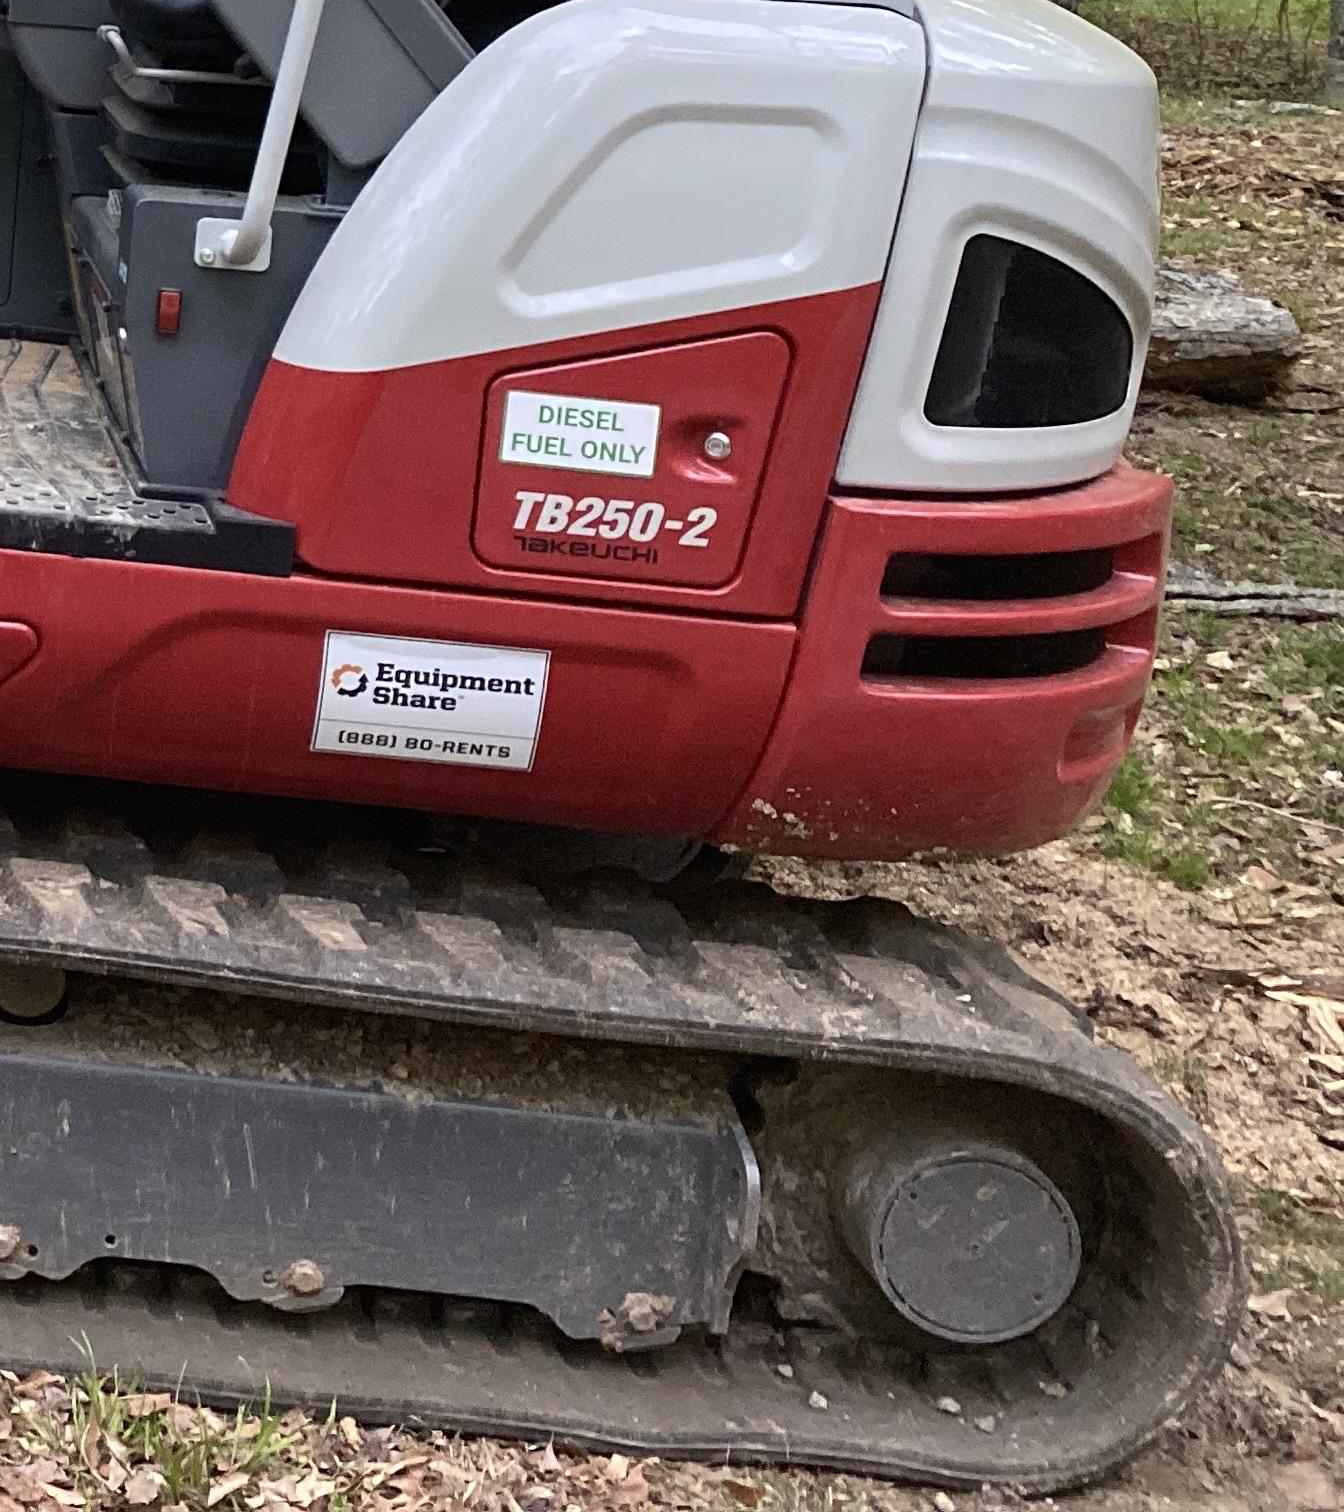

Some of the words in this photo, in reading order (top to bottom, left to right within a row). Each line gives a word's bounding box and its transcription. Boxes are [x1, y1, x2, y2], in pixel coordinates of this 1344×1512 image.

[538, 404, 625, 432] DIESEL
[511, 432, 573, 457] FUEL
[580, 440, 646, 465] ONLY
[513, 490, 718, 547] TB250-2
[375, 662, 536, 696] Equipment
[372, 686, 457, 711] Share
[338, 730, 398, 748] (888)
